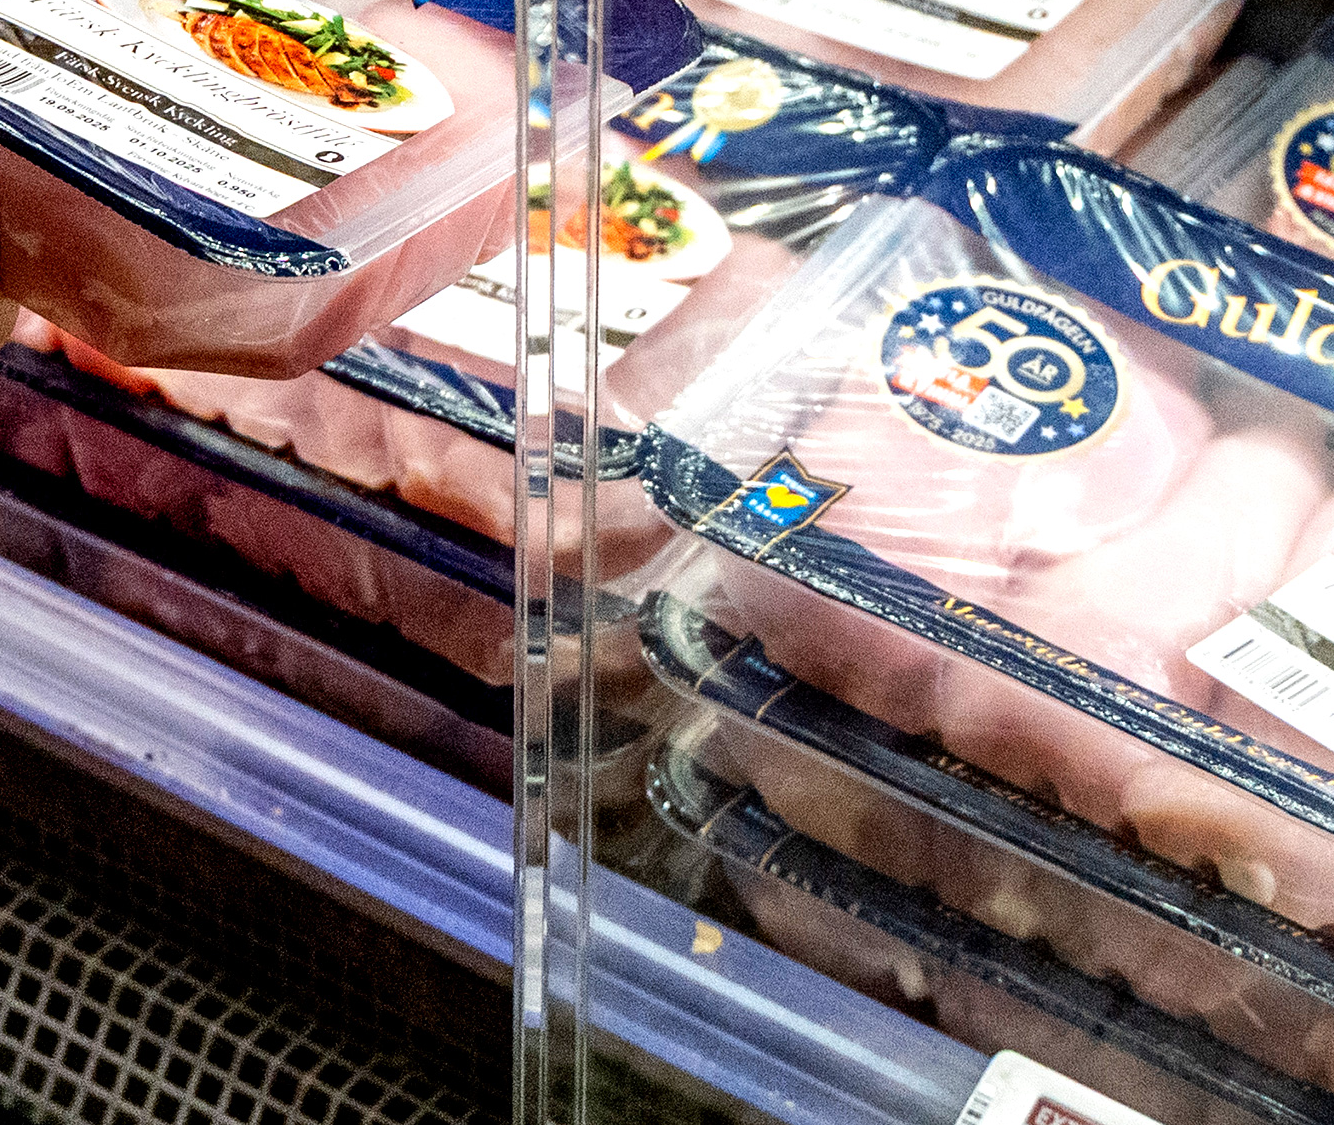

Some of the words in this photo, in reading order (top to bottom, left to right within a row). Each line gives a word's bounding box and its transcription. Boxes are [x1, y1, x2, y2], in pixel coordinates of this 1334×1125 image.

[38, 95, 112, 132] 19.09.2025
[53, 50, 101, 80] Färsk
[101, 76, 162, 108] Svensk
[164, 99, 239, 148] Kyckling
[129, 137, 204, 175] 01.10.2025
